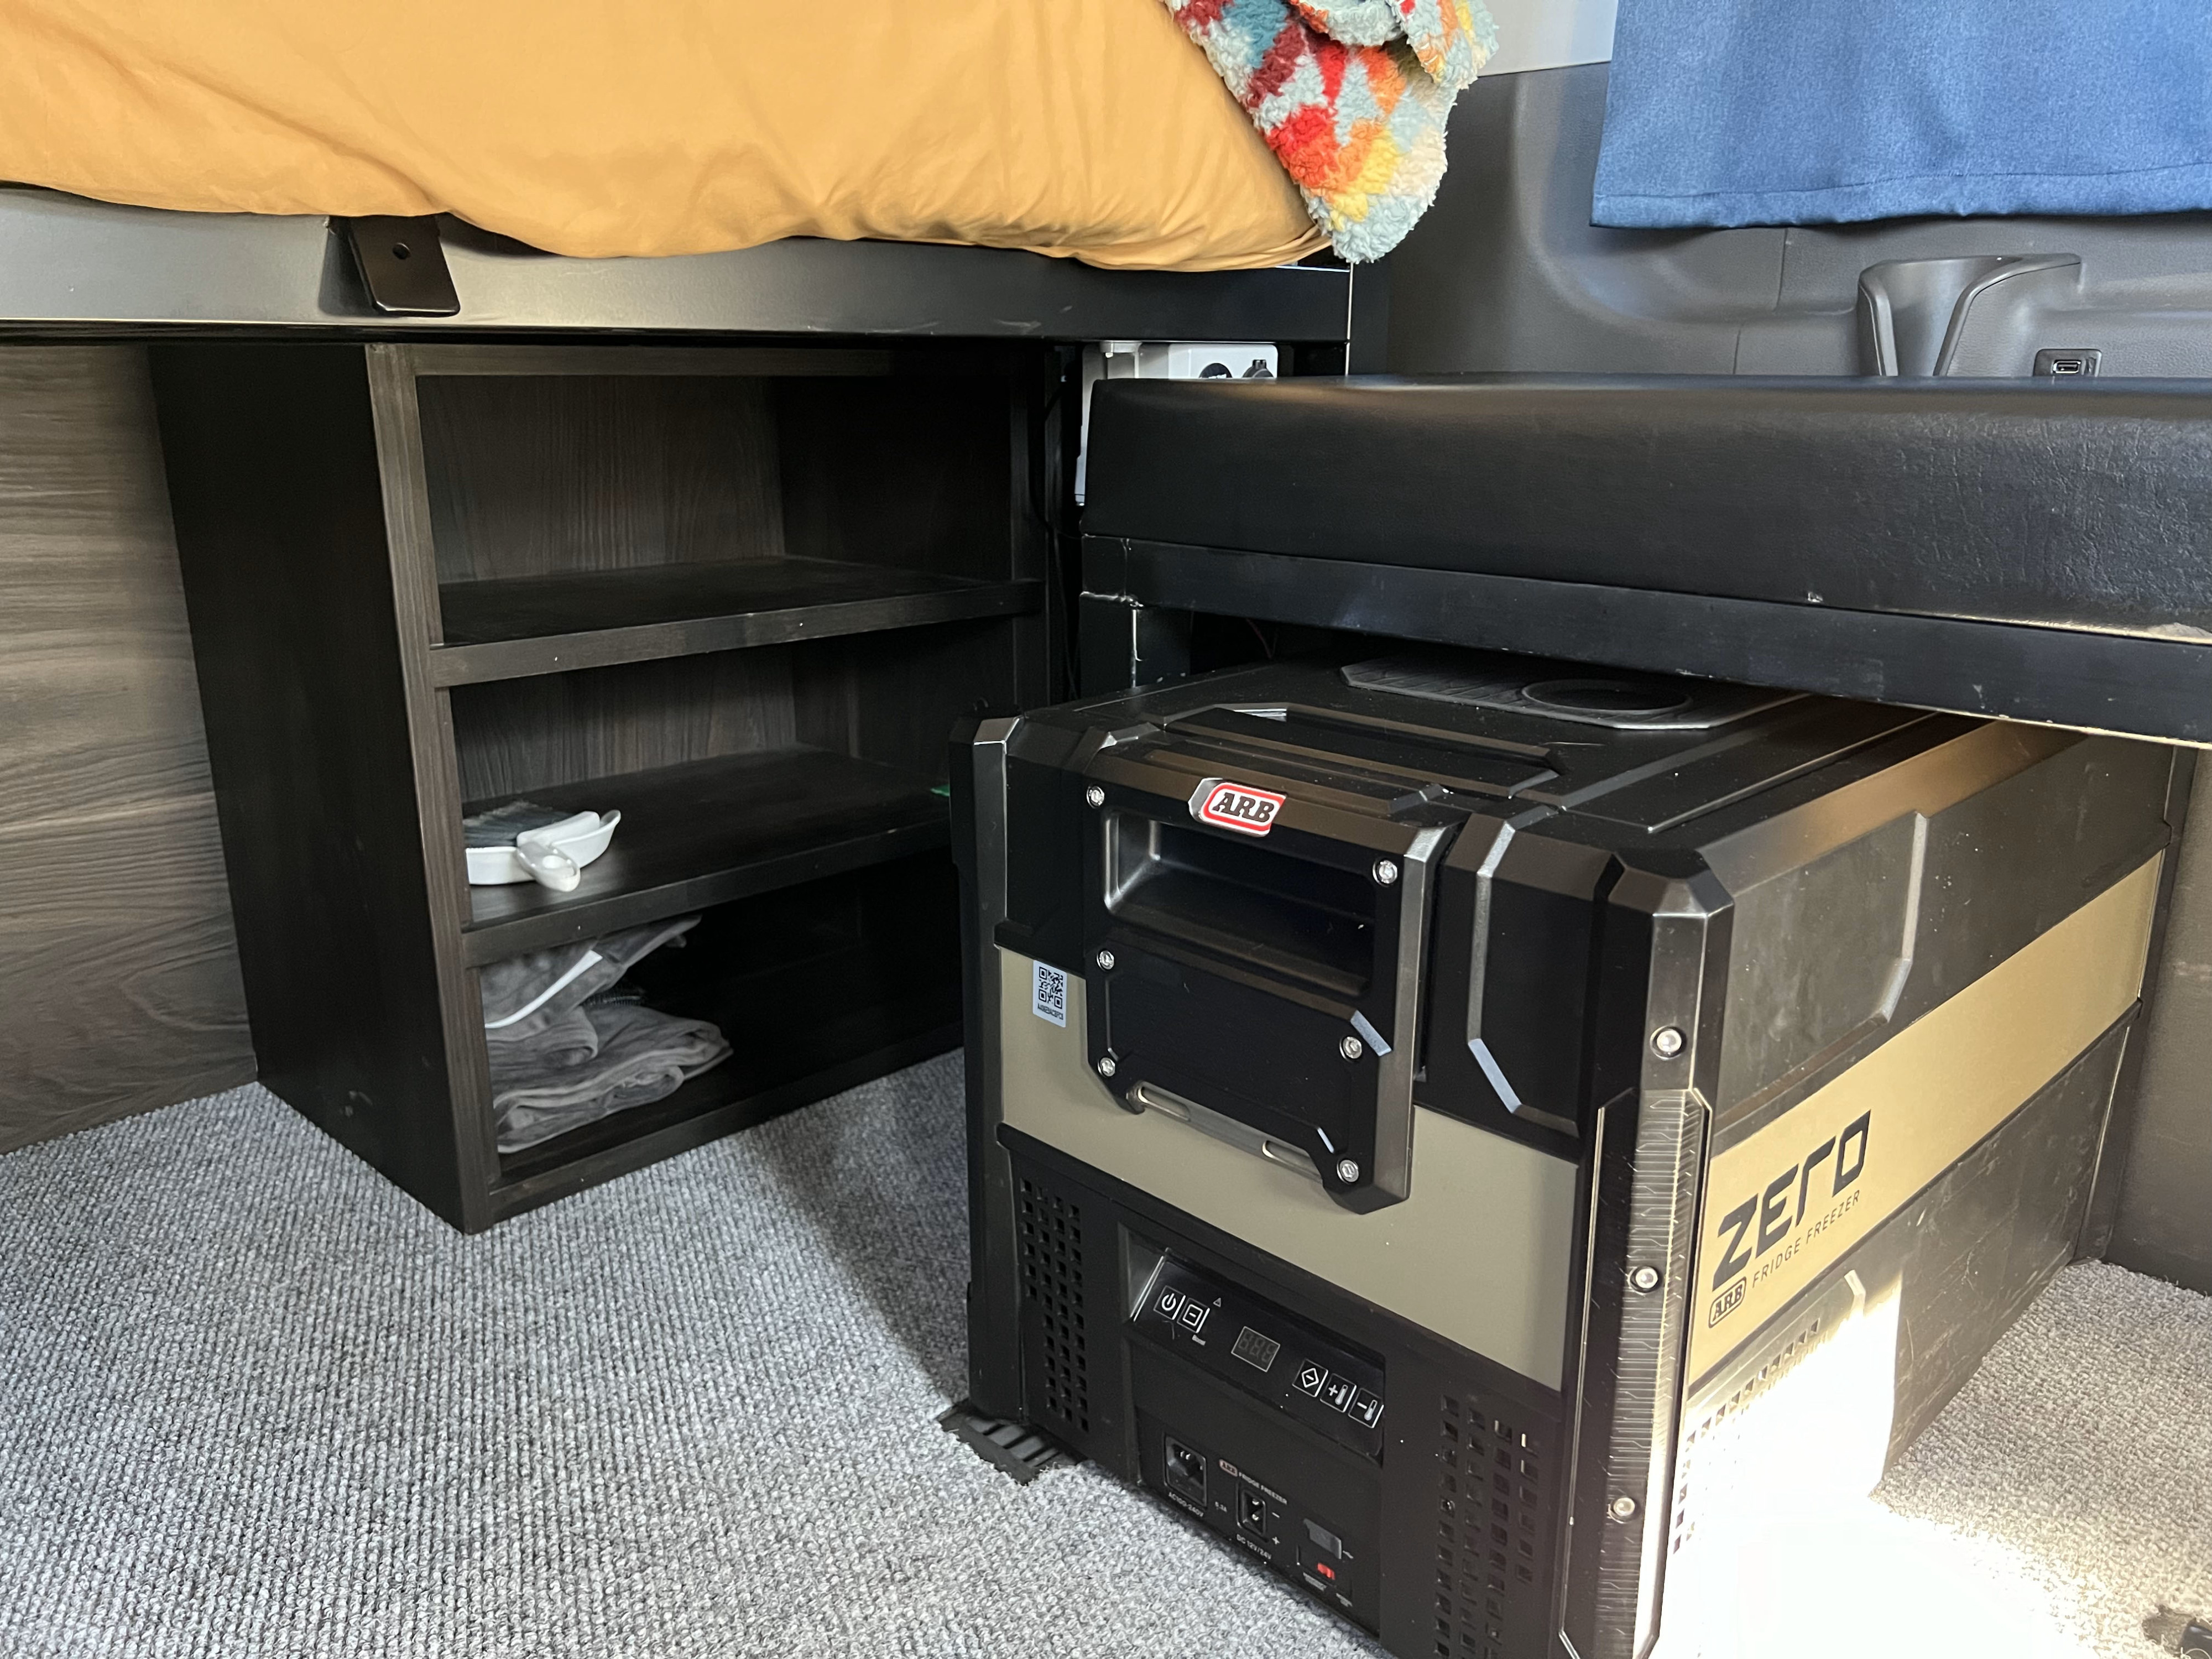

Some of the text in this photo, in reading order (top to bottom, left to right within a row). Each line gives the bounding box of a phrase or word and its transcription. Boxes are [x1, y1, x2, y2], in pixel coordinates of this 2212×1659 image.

[1212, 792, 1274, 822] ARB
[1712, 1109, 1871, 1292] ZERO
[1712, 1190, 1860, 1322] ARB FRIDGE FREEZER
[1238, 1472, 1260, 1489] FRIDGE
[1261, 1485, 1287, 1505] FREEZER
